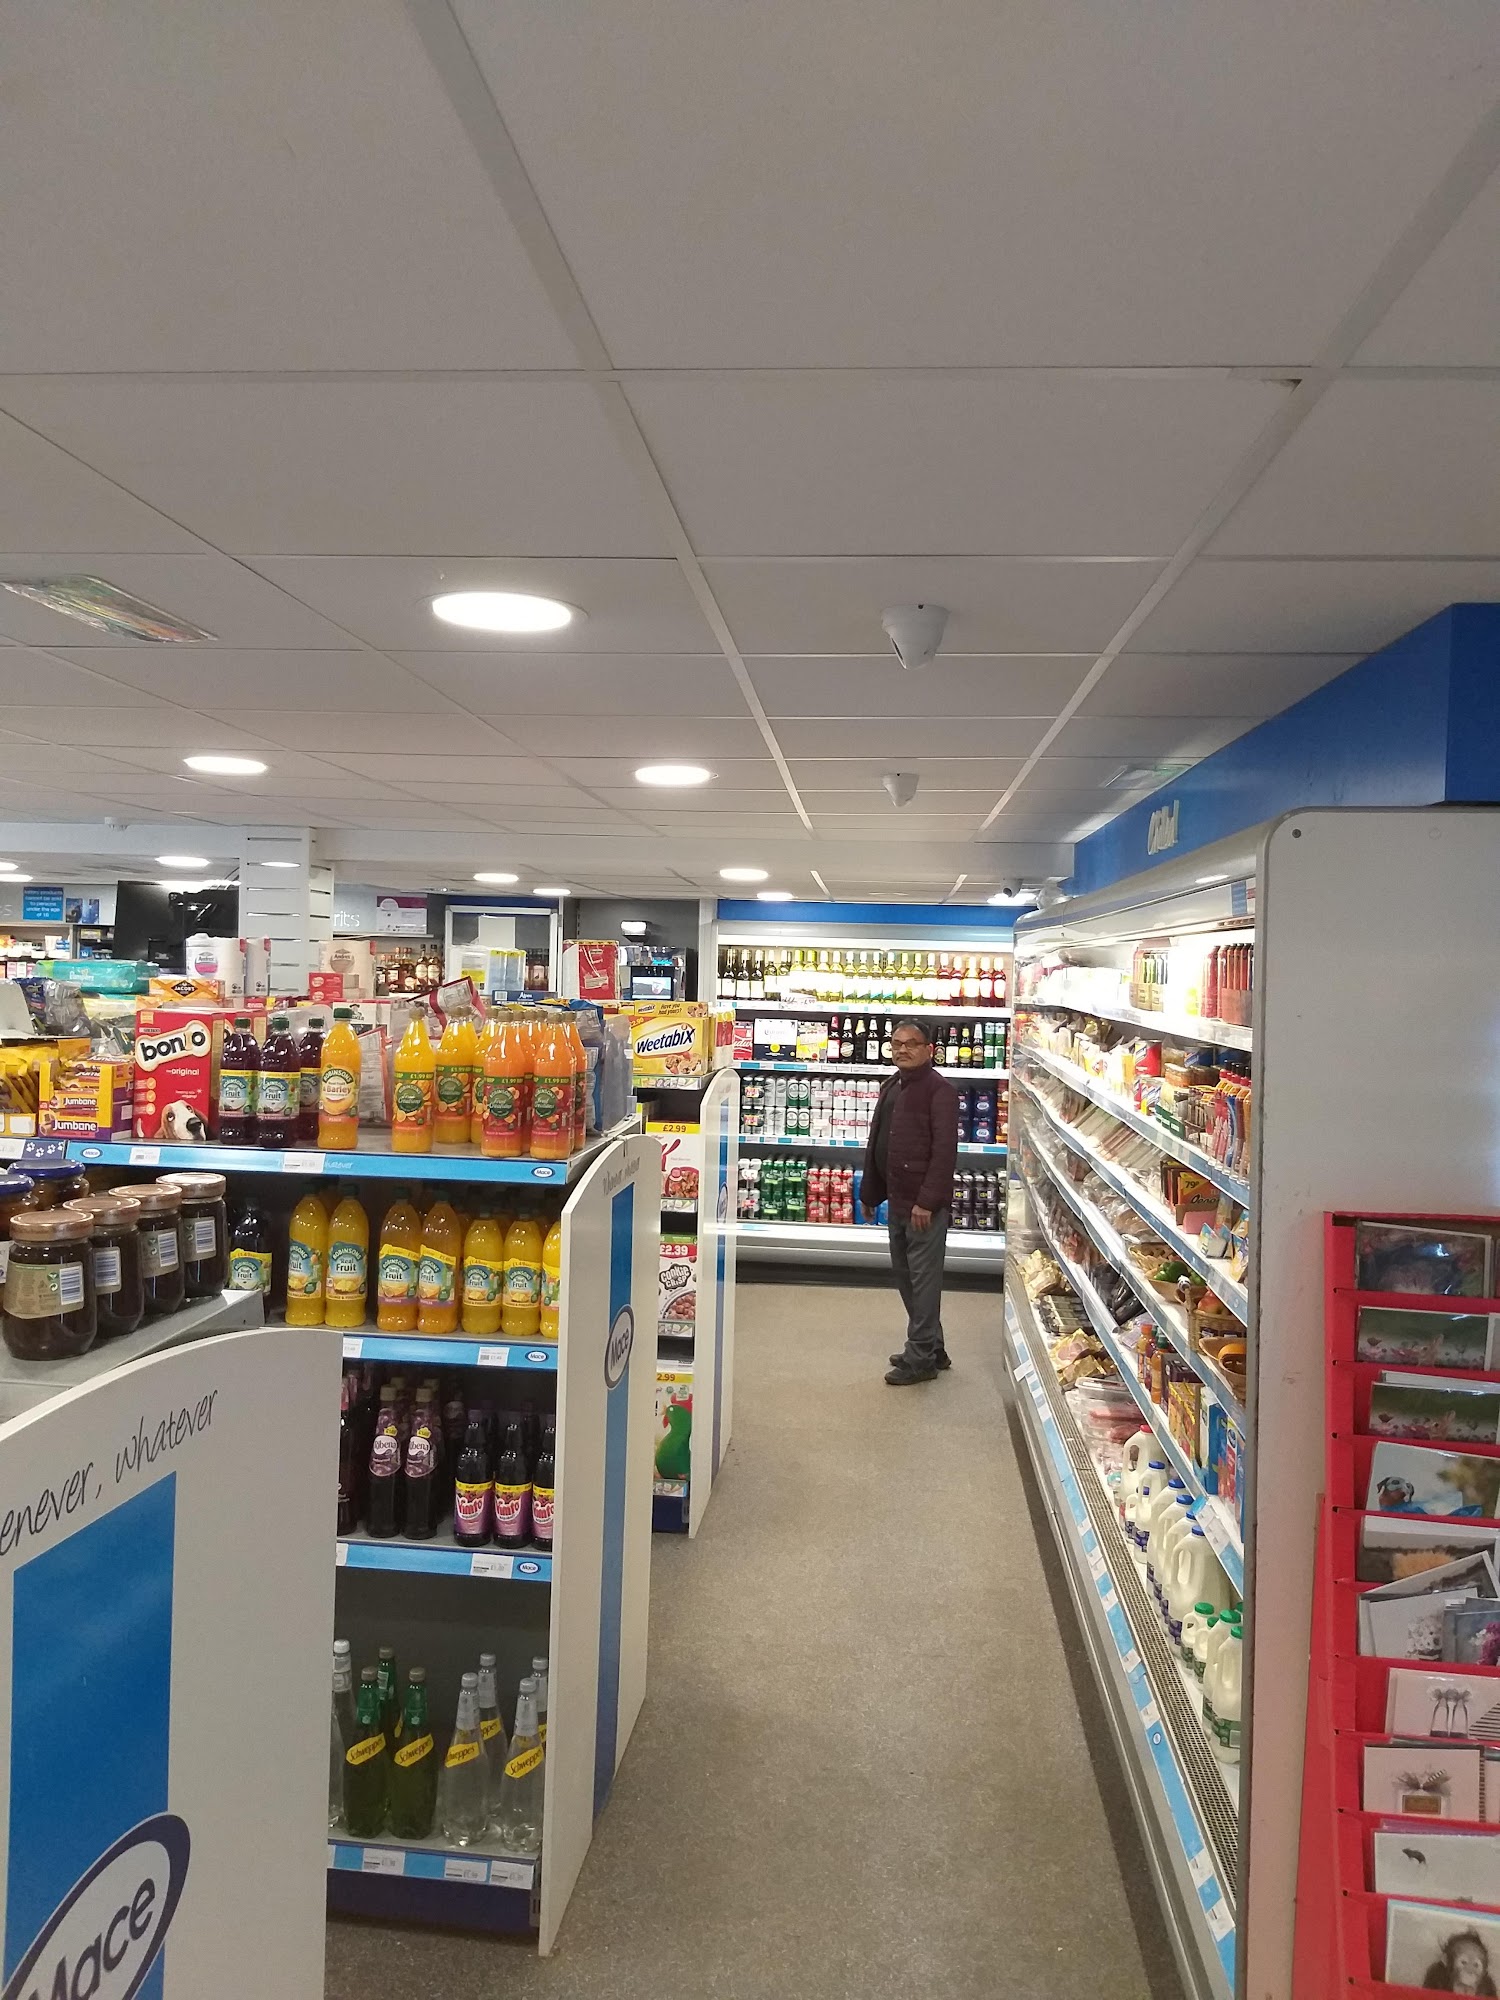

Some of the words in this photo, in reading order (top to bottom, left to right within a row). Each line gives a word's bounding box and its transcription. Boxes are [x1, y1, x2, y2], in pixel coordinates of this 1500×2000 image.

[636, 1027, 696, 1054] Weetabix
[171, 1067, 200, 1077] original
[323, 1069, 353, 1083] ROBINSONS
[327, 1085, 352, 1094] Barley
[265, 1092, 282, 1100] Fruit
[64, 1097, 97, 1106] Jumbone
[53, 1120, 98, 1132] Jumbone
[662, 1124, 687, 1133] £2.99
[535, 1167, 551, 1175] Mace
[332, 1247, 362, 1260] ROBINSONS
[660, 1244, 689, 1256] £2.39
[335, 1263, 357, 1272] Fruit
[382, 1259, 408, 1270] ROBINSONS
[385, 1271, 403, 1280] Fruit
[529, 1352, 545, 1360] Mace
[115, 1390, 218, 1483] whatever
[457, 1496, 484, 1516] Vimto
[521, 1563, 537, 1571] Mace
